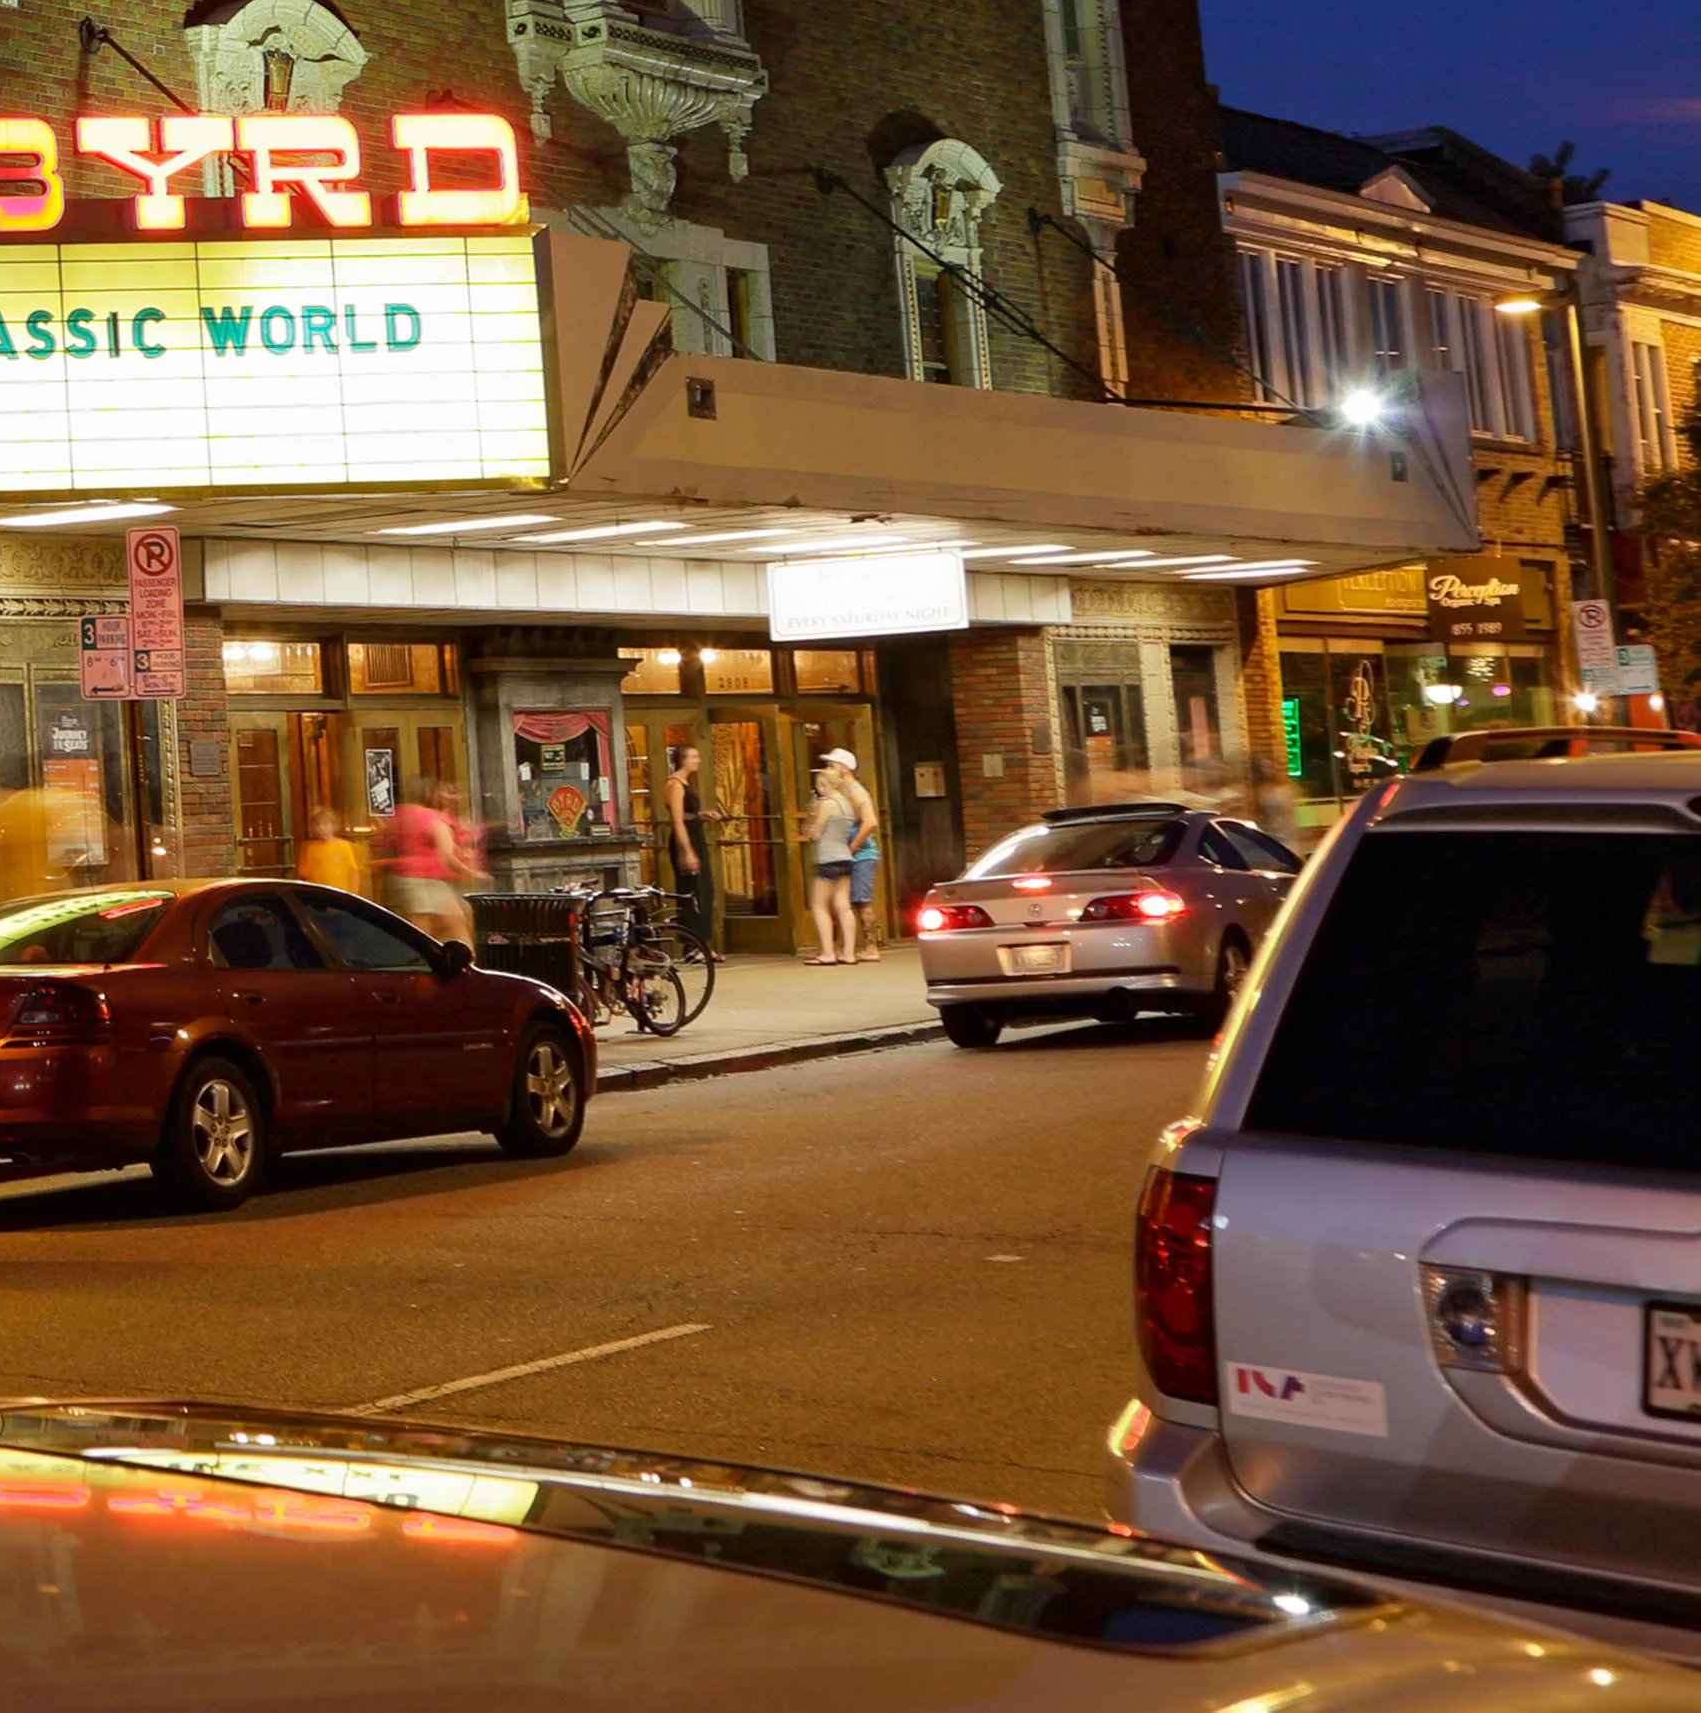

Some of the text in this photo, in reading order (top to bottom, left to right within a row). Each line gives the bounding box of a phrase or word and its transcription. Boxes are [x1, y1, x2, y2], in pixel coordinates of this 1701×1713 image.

[199, 302, 422, 358] WORLD
[134, 577, 176, 587] PASSENGER
[139, 589, 172, 598] LOADING
[146, 599, 166, 608] ZONE
[788, 605, 950, 629] EVERY SATURDAY NIGHT
[83, 620, 121, 645] 3 HOUR
[98, 634, 126, 644] PARKING
[138, 652, 149, 669] 3
[552, 792, 581, 813] BYRD
